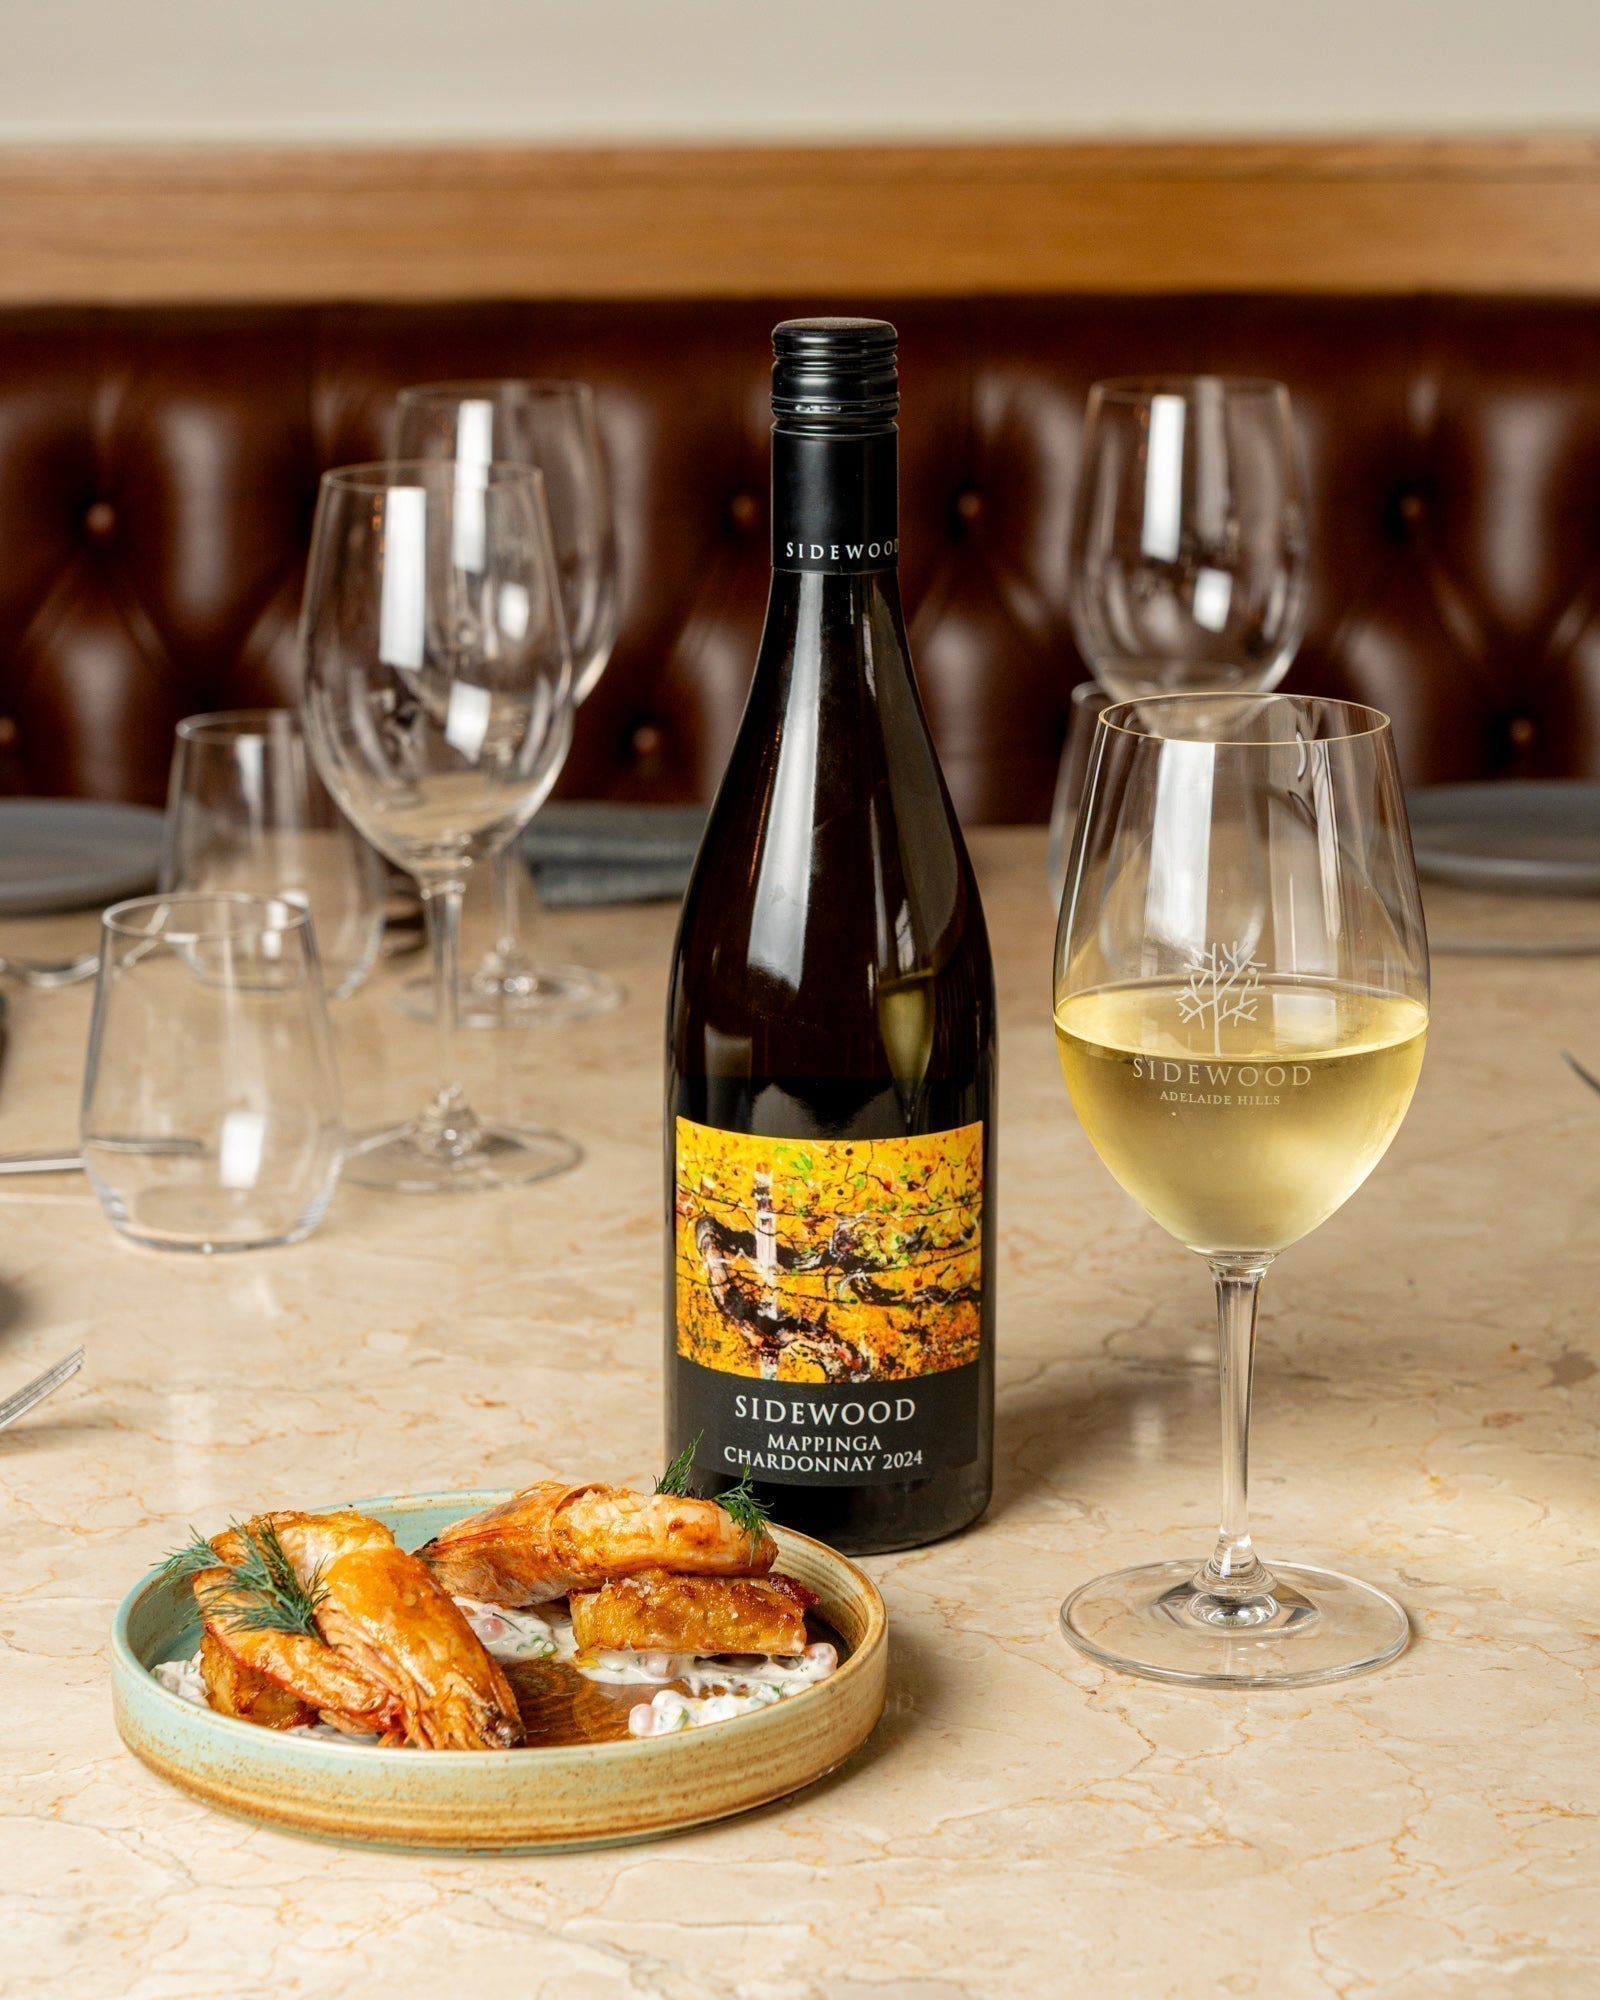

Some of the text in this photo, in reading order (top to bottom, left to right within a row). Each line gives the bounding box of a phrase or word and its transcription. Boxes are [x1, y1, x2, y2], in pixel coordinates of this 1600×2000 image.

[1132, 1057, 1312, 1087] SIDEWOOD
[1159, 1090, 1281, 1105] ADELAIDE HILLS
[735, 1395, 916, 1426] SIDEWOOD
[767, 1433, 882, 1452] MAPPINGA
[724, 1446, 924, 1473] CHARDONNAY 2024
